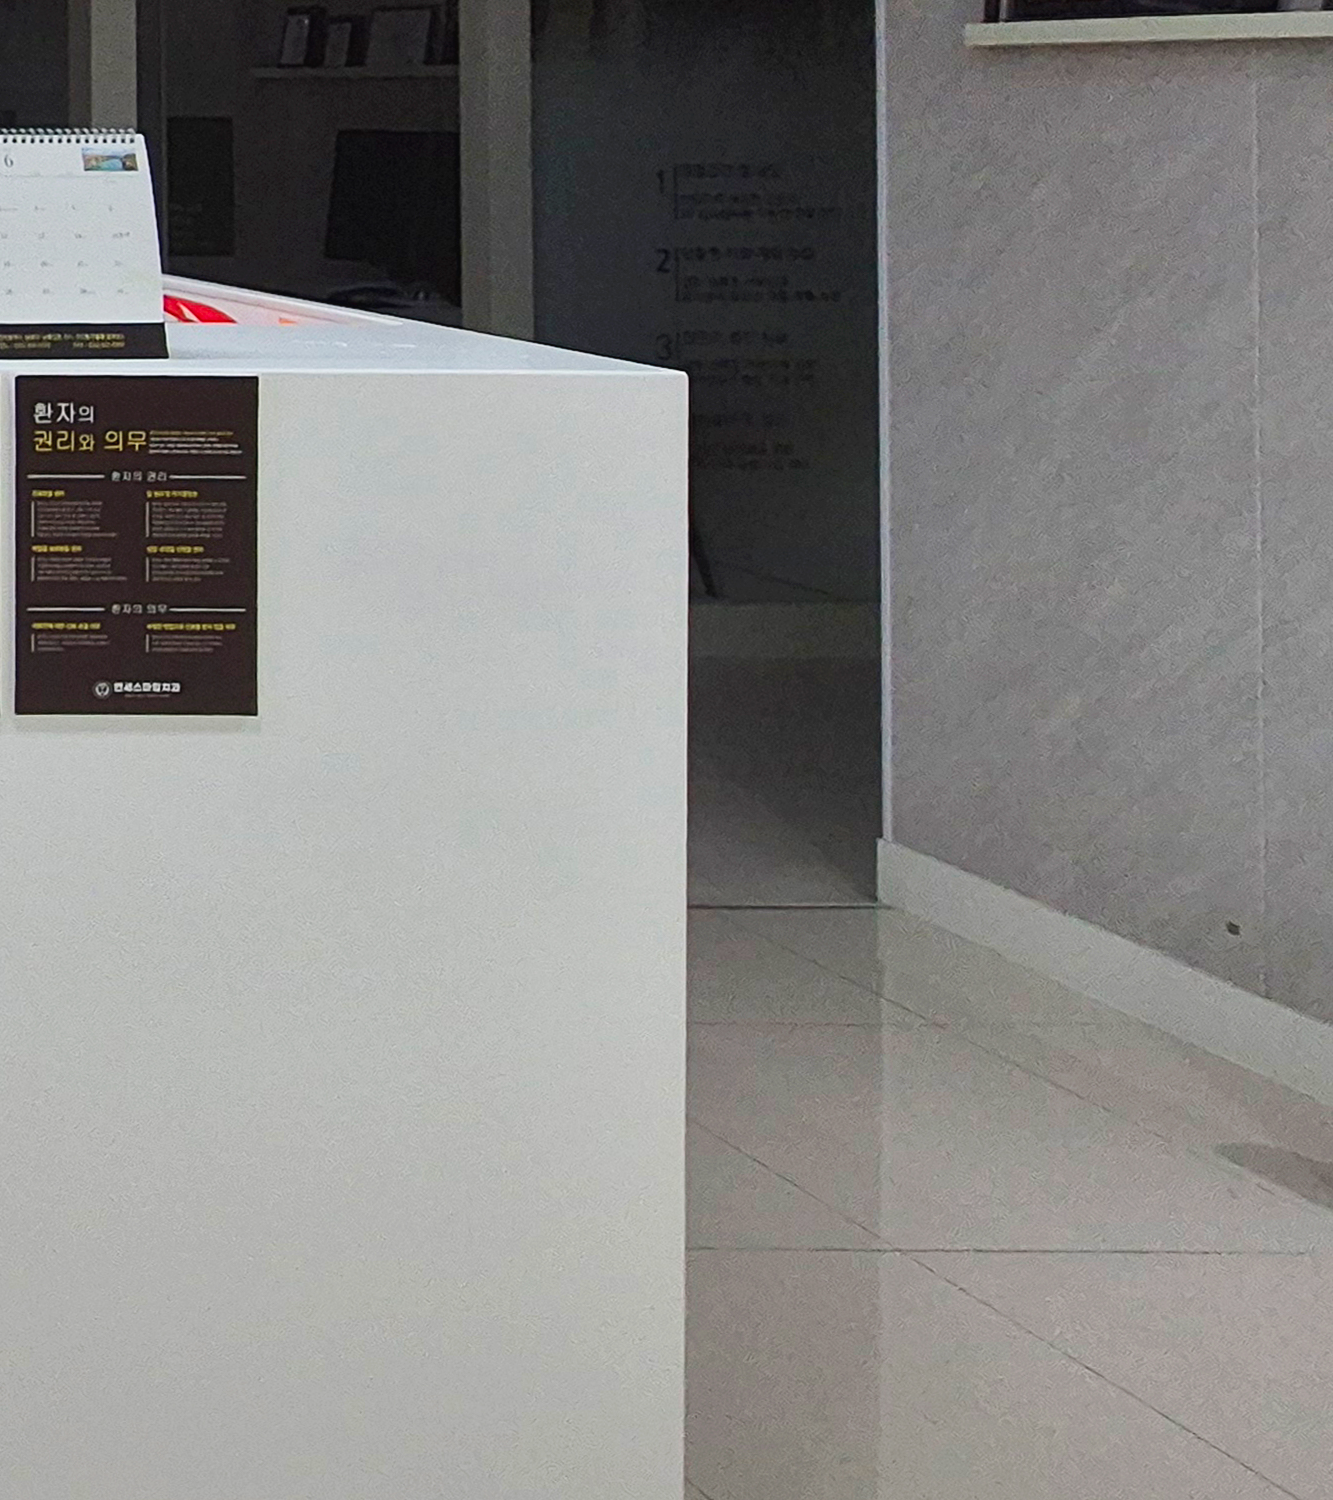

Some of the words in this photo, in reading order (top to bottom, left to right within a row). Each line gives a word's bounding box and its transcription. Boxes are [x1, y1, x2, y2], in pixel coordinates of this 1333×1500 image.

[3, 154, 14, 168] 6
[33, 401, 95, 424] 환자의
[33, 429, 95, 452] 권리와
[104, 429, 147, 452] 의무
